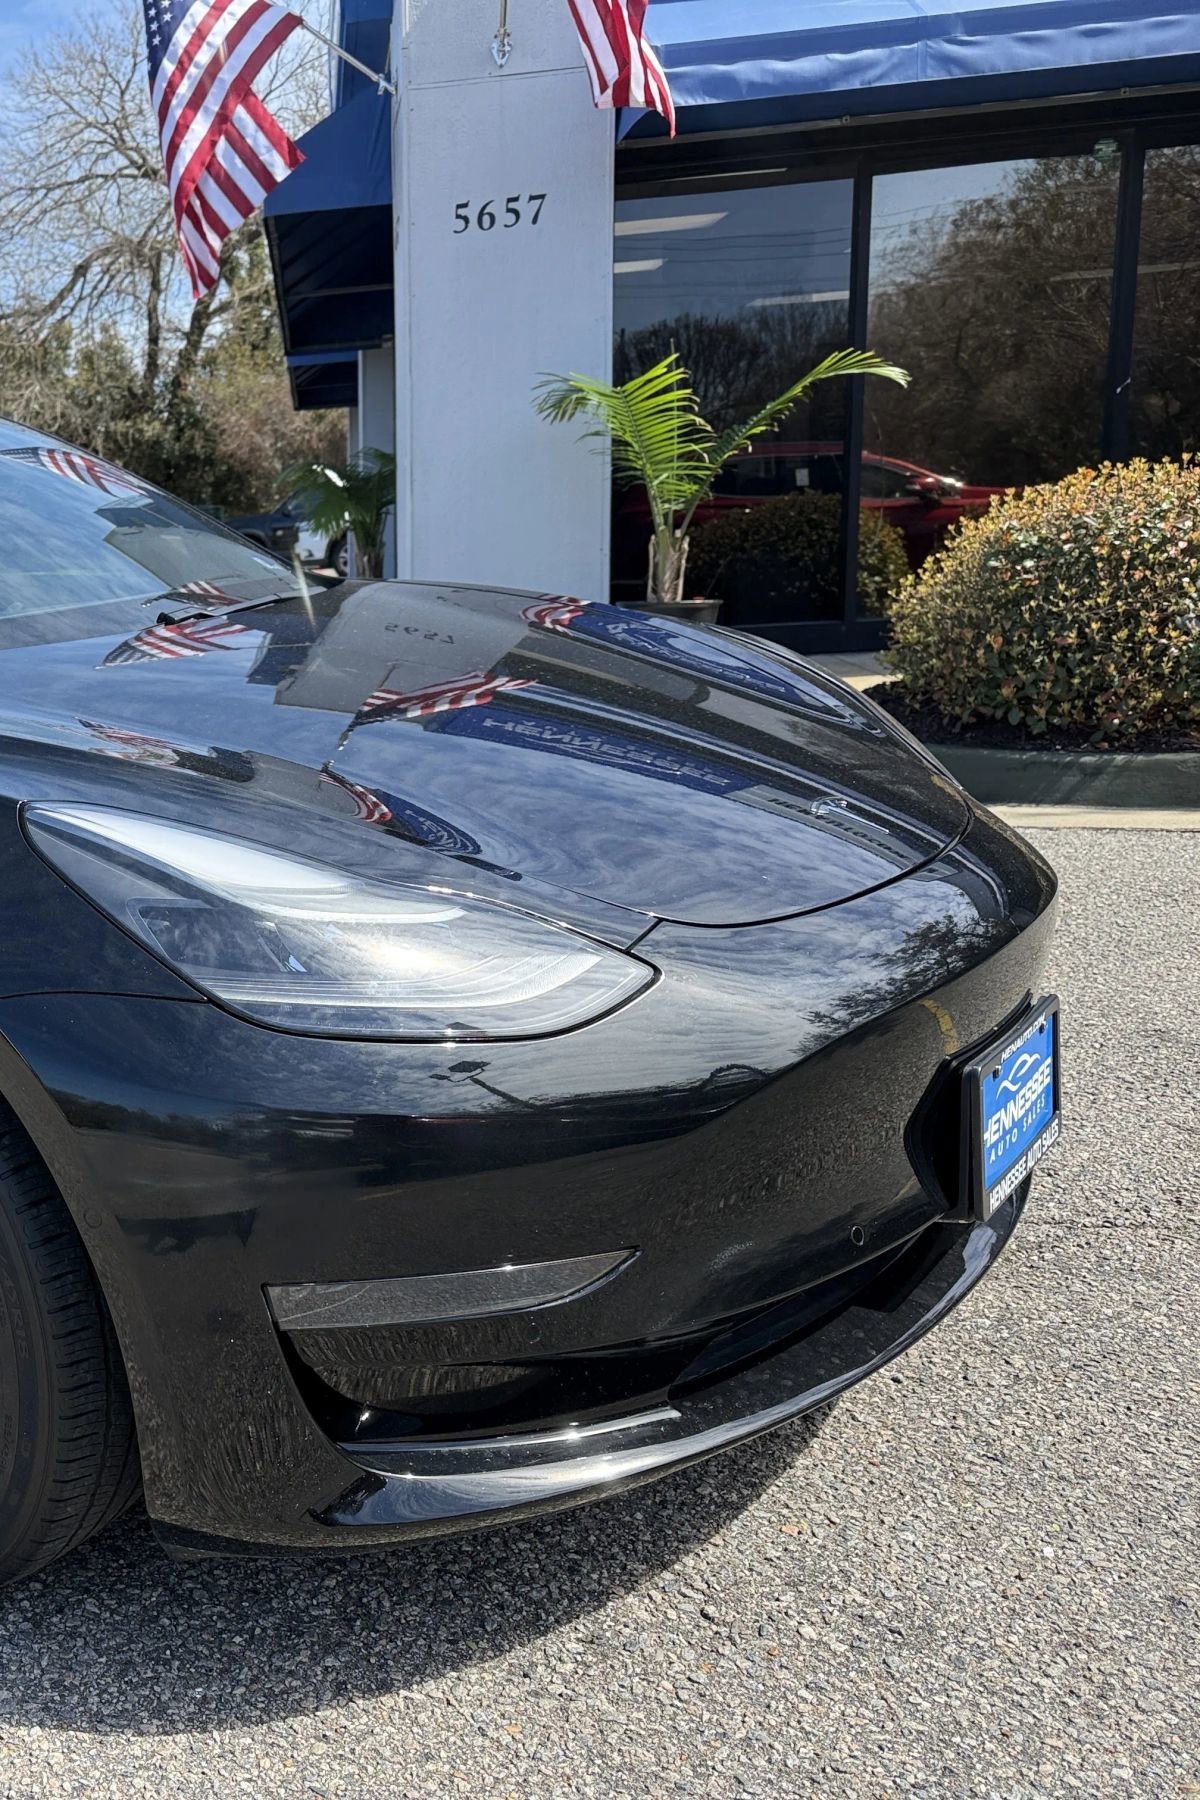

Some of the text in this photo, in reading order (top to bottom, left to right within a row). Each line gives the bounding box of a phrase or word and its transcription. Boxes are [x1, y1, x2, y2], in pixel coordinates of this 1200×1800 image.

[453, 193, 547, 234] 5657
[984, 1056, 1052, 1148] HENNESSEE
[990, 1093, 1045, 1164] AUTO SALES
[990, 1118, 1059, 1214] HENNESSEE AUTO SALES
